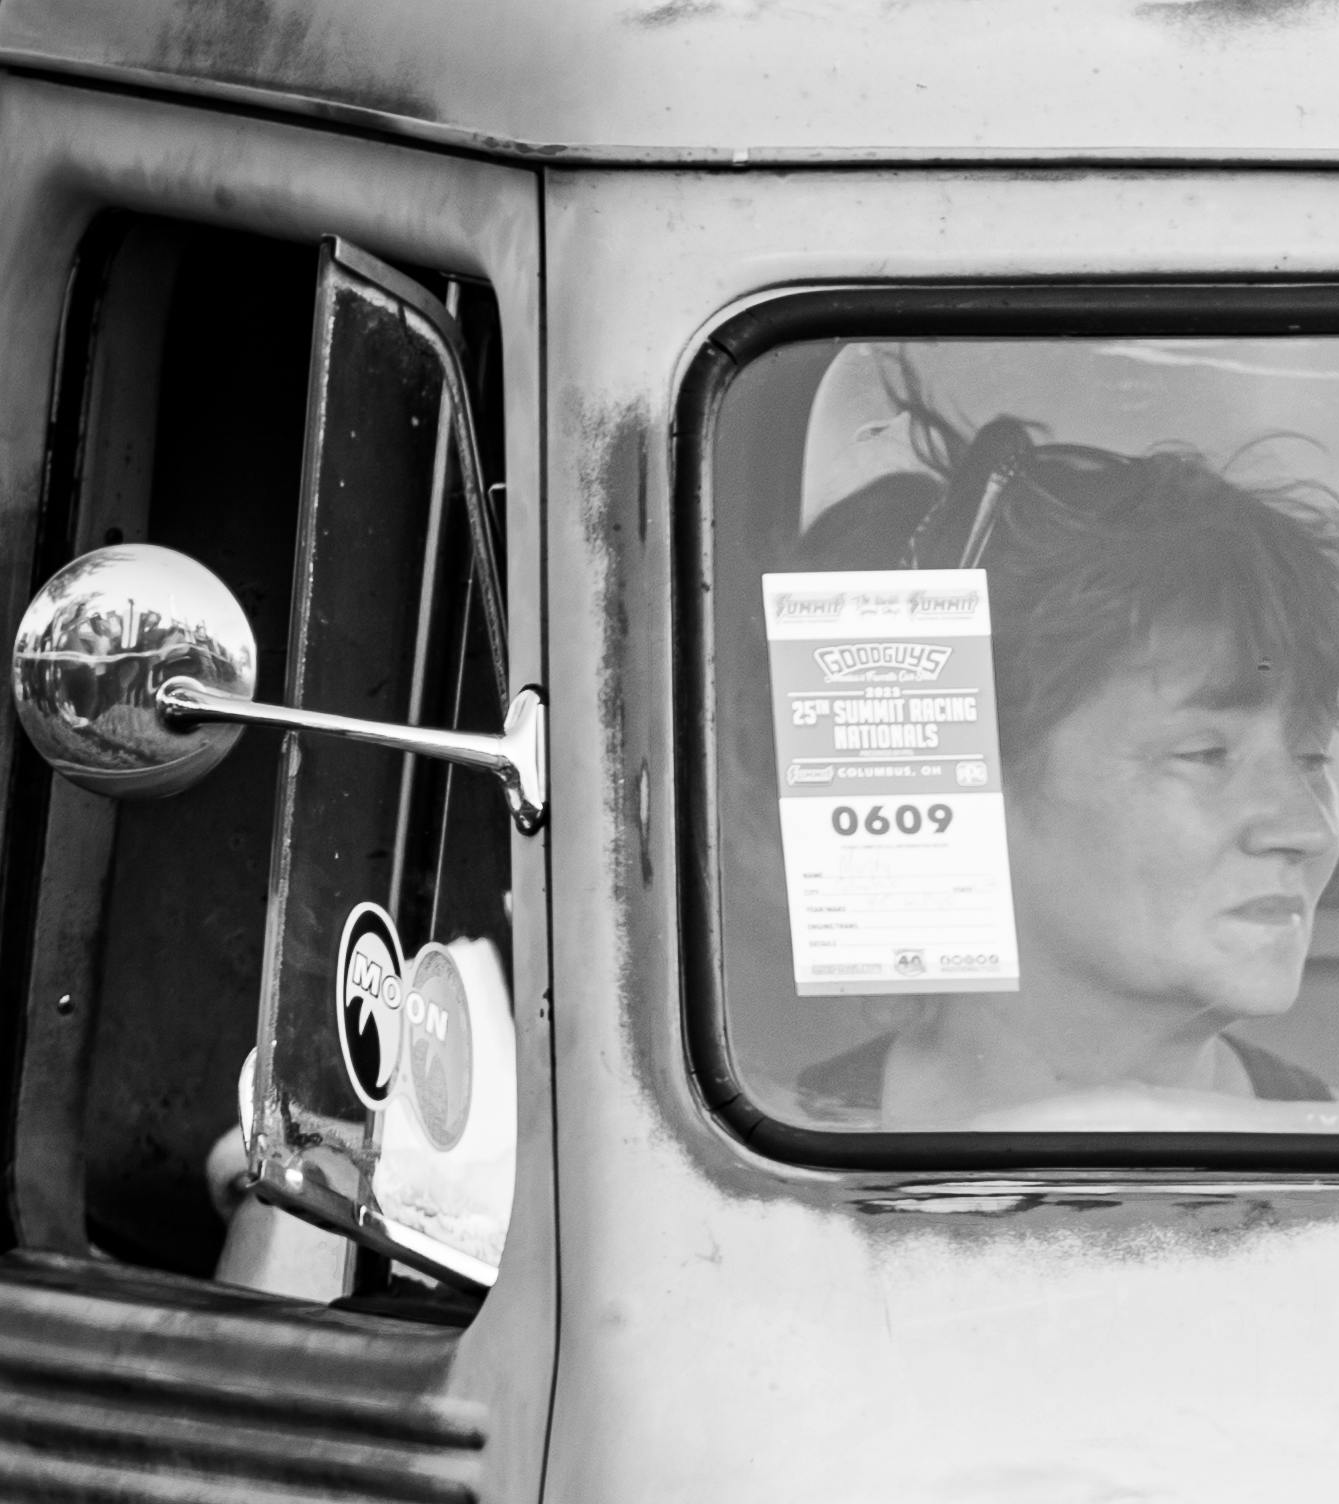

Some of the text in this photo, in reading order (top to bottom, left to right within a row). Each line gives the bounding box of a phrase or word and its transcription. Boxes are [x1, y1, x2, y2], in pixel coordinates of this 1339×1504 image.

[775, 592, 846, 618] SUMMIT
[908, 589, 979, 615] SUMMIT
[819, 646, 948, 675] GOODGUYS
[833, 698, 906, 724] SUMMIT
[909, 696, 977, 722] RACING
[834, 723, 939, 750] NATIONALS
[837, 765, 942, 778] COLUMBUS, OH
[831, 803, 954, 837] 0609
[352, 951, 449, 1042] MOON
